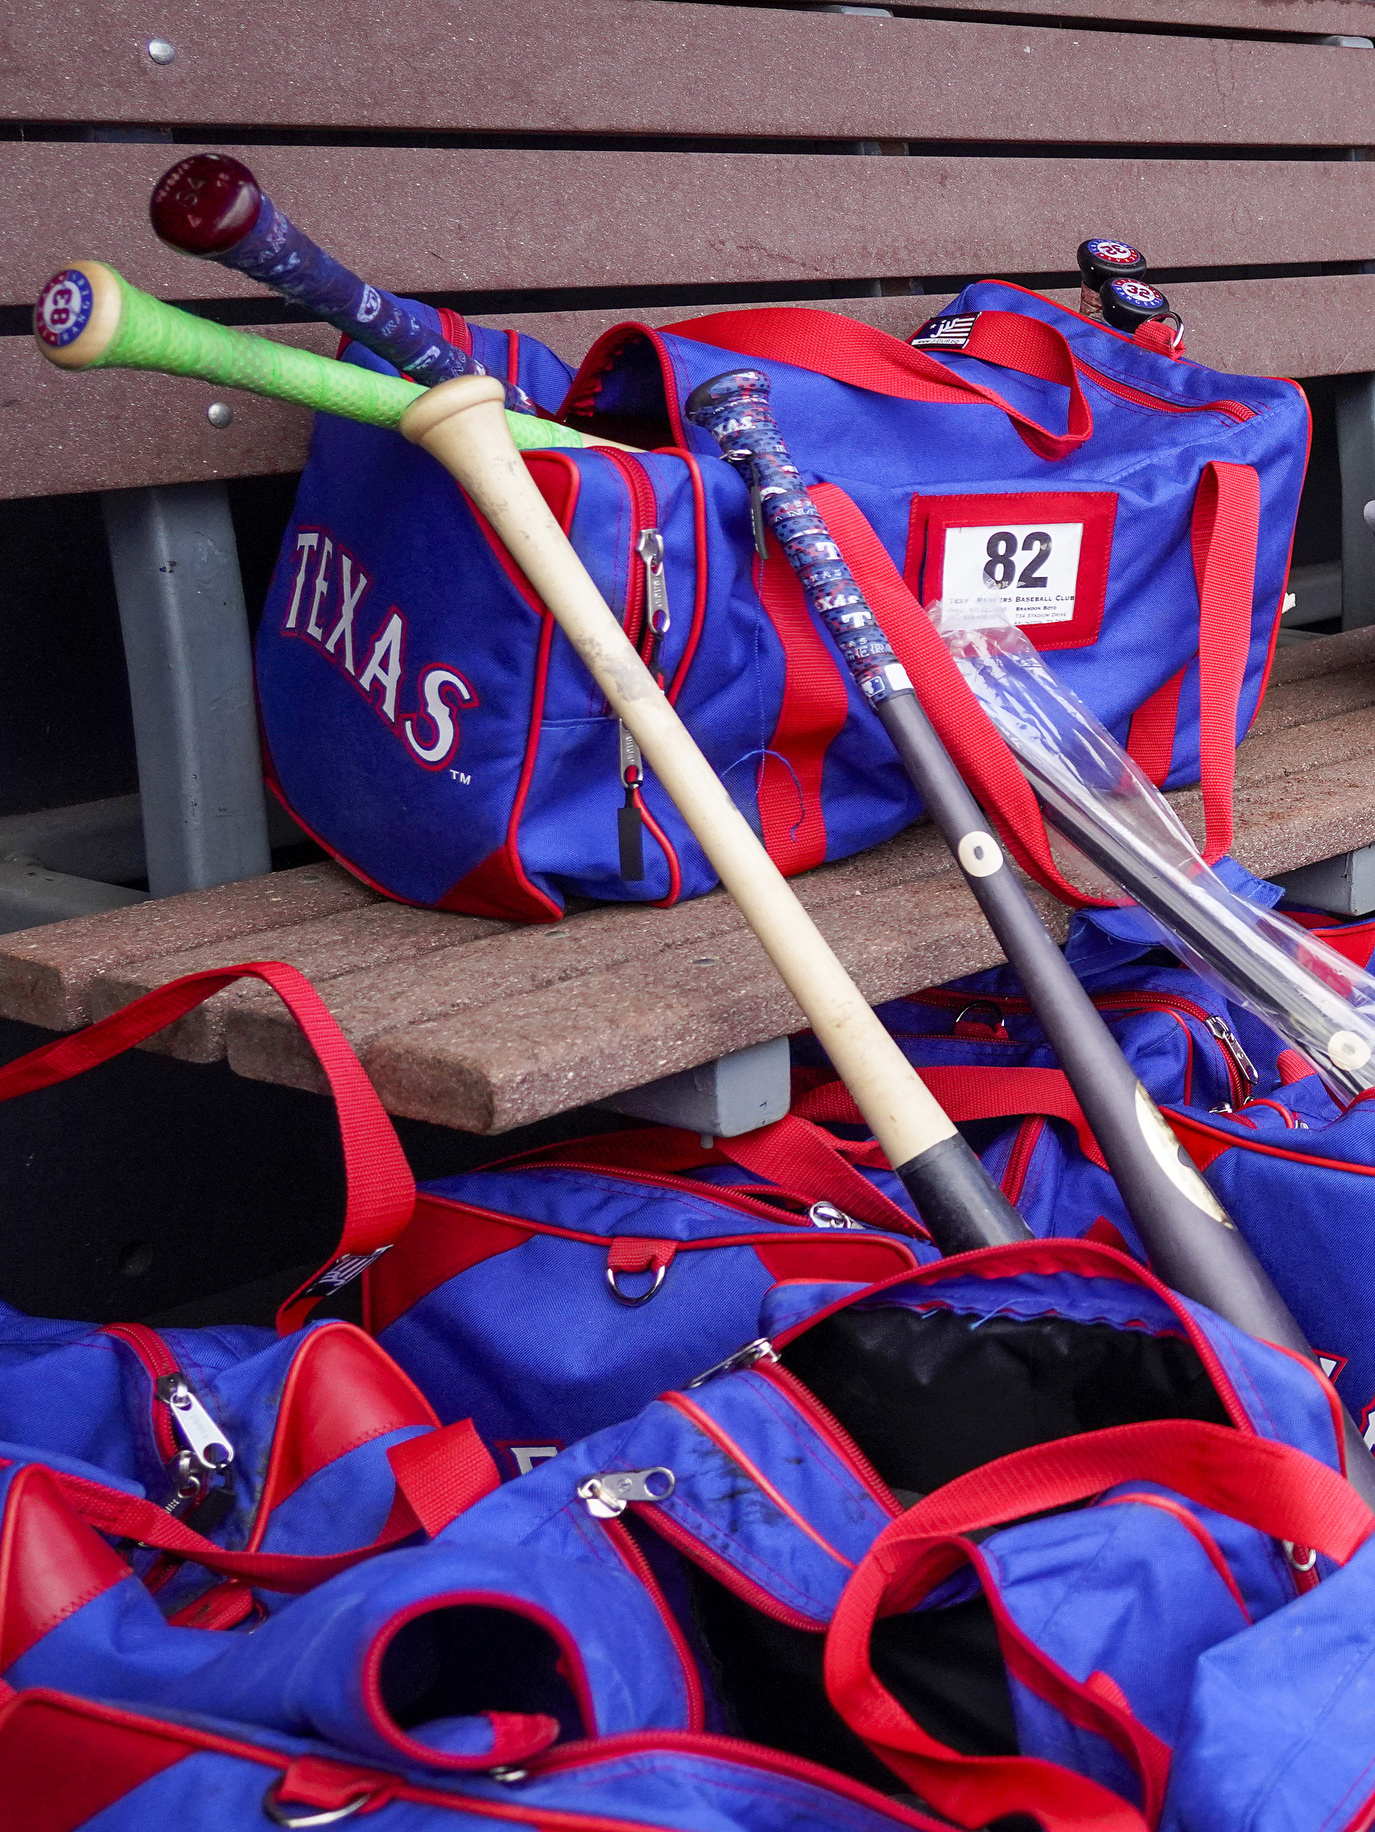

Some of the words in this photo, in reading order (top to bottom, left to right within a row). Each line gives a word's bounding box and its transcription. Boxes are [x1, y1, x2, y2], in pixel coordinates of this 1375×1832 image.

[1126, 284, 1151, 300] 32
[983, 531, 1053, 590] 82
[1015, 595, 1053, 604] BASEBALL
[1055, 594, 1075, 603] CLUB
[284, 530, 474, 765] TEXAS
[450, 769, 472, 786] TM
